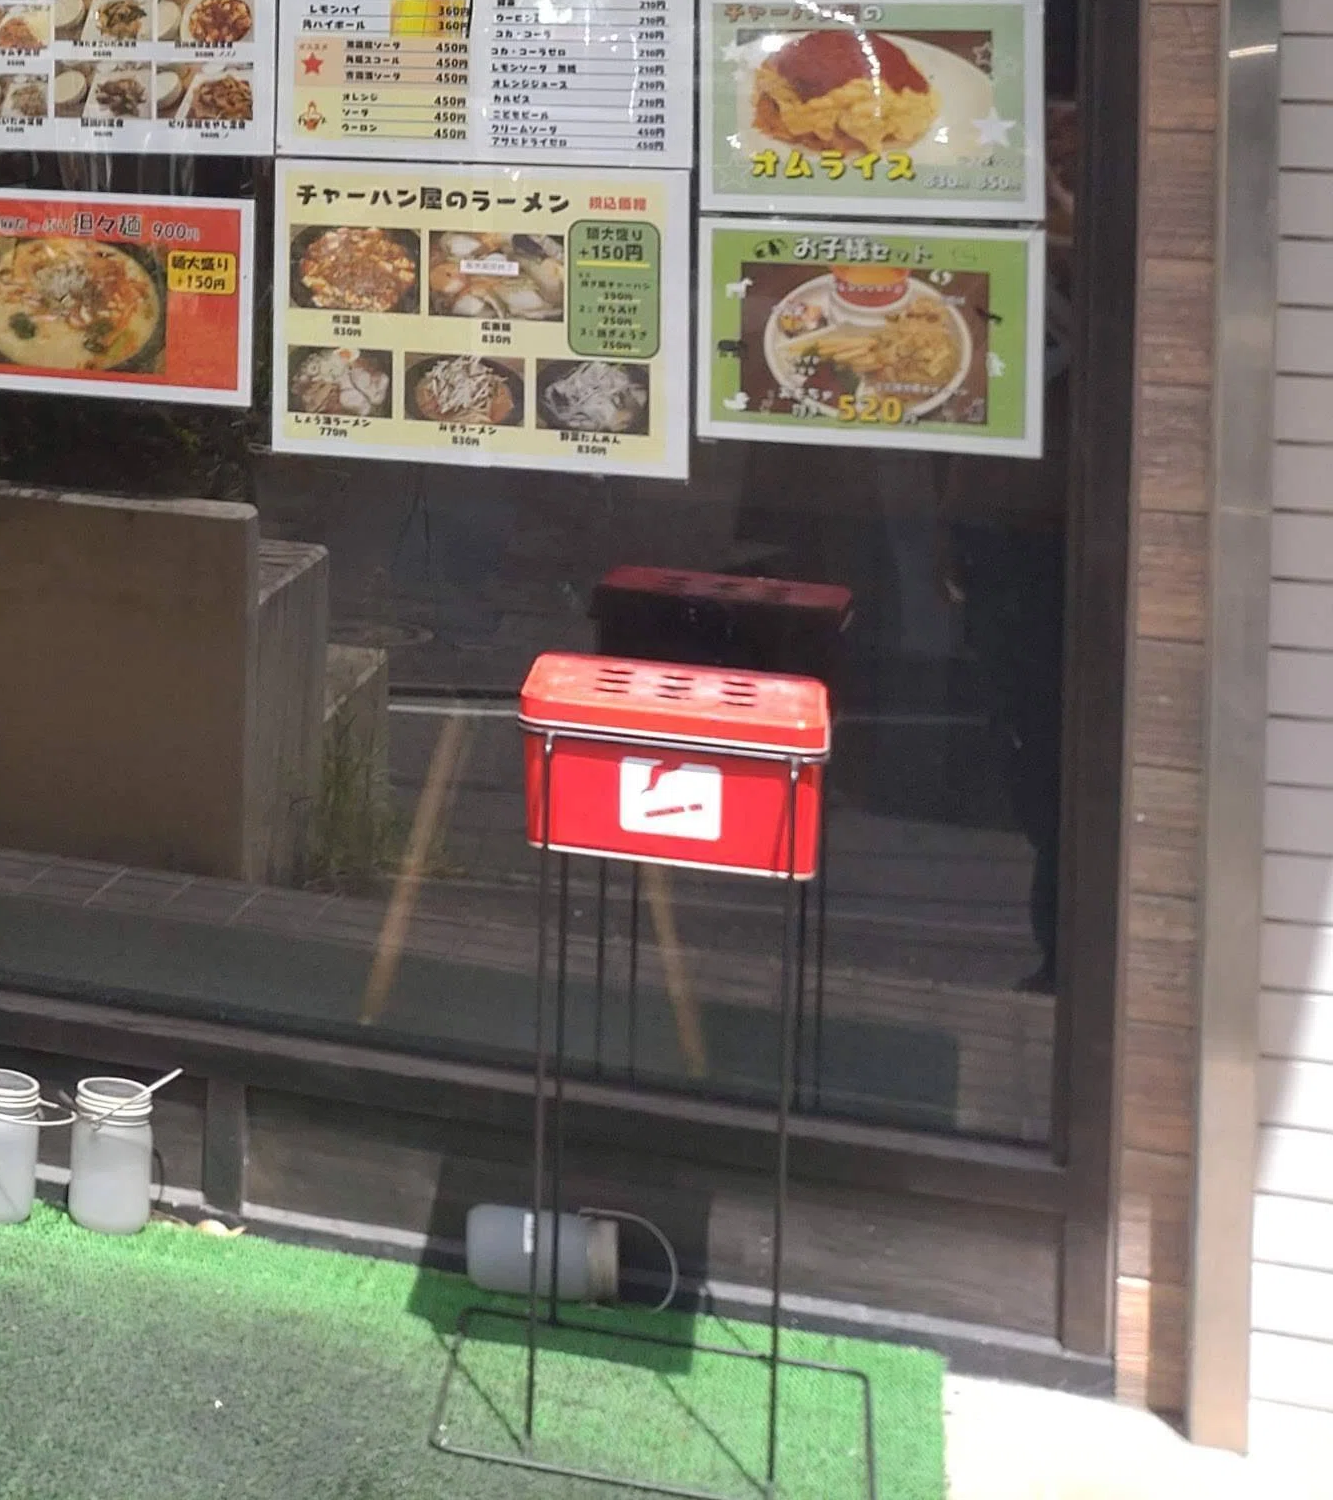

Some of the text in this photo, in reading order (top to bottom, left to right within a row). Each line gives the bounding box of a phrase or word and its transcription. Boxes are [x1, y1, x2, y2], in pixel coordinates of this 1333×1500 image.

[309, 5, 470, 17] レモンハイ 360円
[303, 20, 469, 31] 角ハイボール 360円
[495, 30, 551, 39] コカ・コーラ
[435, 43, 468, 54] 450円
[491, 47, 567, 57] コカ・コーラゼロ
[435, 58, 468, 69] 450円
[491, 63, 547, 72] レモンソーダ
[435, 73, 468, 84] 450円
[492, 80, 568, 89] オレンジジュース
[342, 93, 467, 108] オレンジ 450円
[342, 108, 467, 123] ソーダ 450円
[341, 123, 467, 140] ウーロン 450円
[491, 124, 558, 135] クリームソーダ
[750, 149, 916, 181] オムライス
[295, 183, 648, 215] チャーハン屋のラーメン 税込価格
[152, 221, 200, 240] 900円
[586, 226, 643, 241] 麺大盛り
[579, 243, 644, 261] +150円
[792, 235, 933, 263] お子様セット
[171, 254, 229, 272] 麺大盛り
[481, 334, 511, 345] 830円
[319, 427, 348, 438] 770円
[438, 424, 497, 436] みそラーメン
[451, 435, 480, 447] 830円
